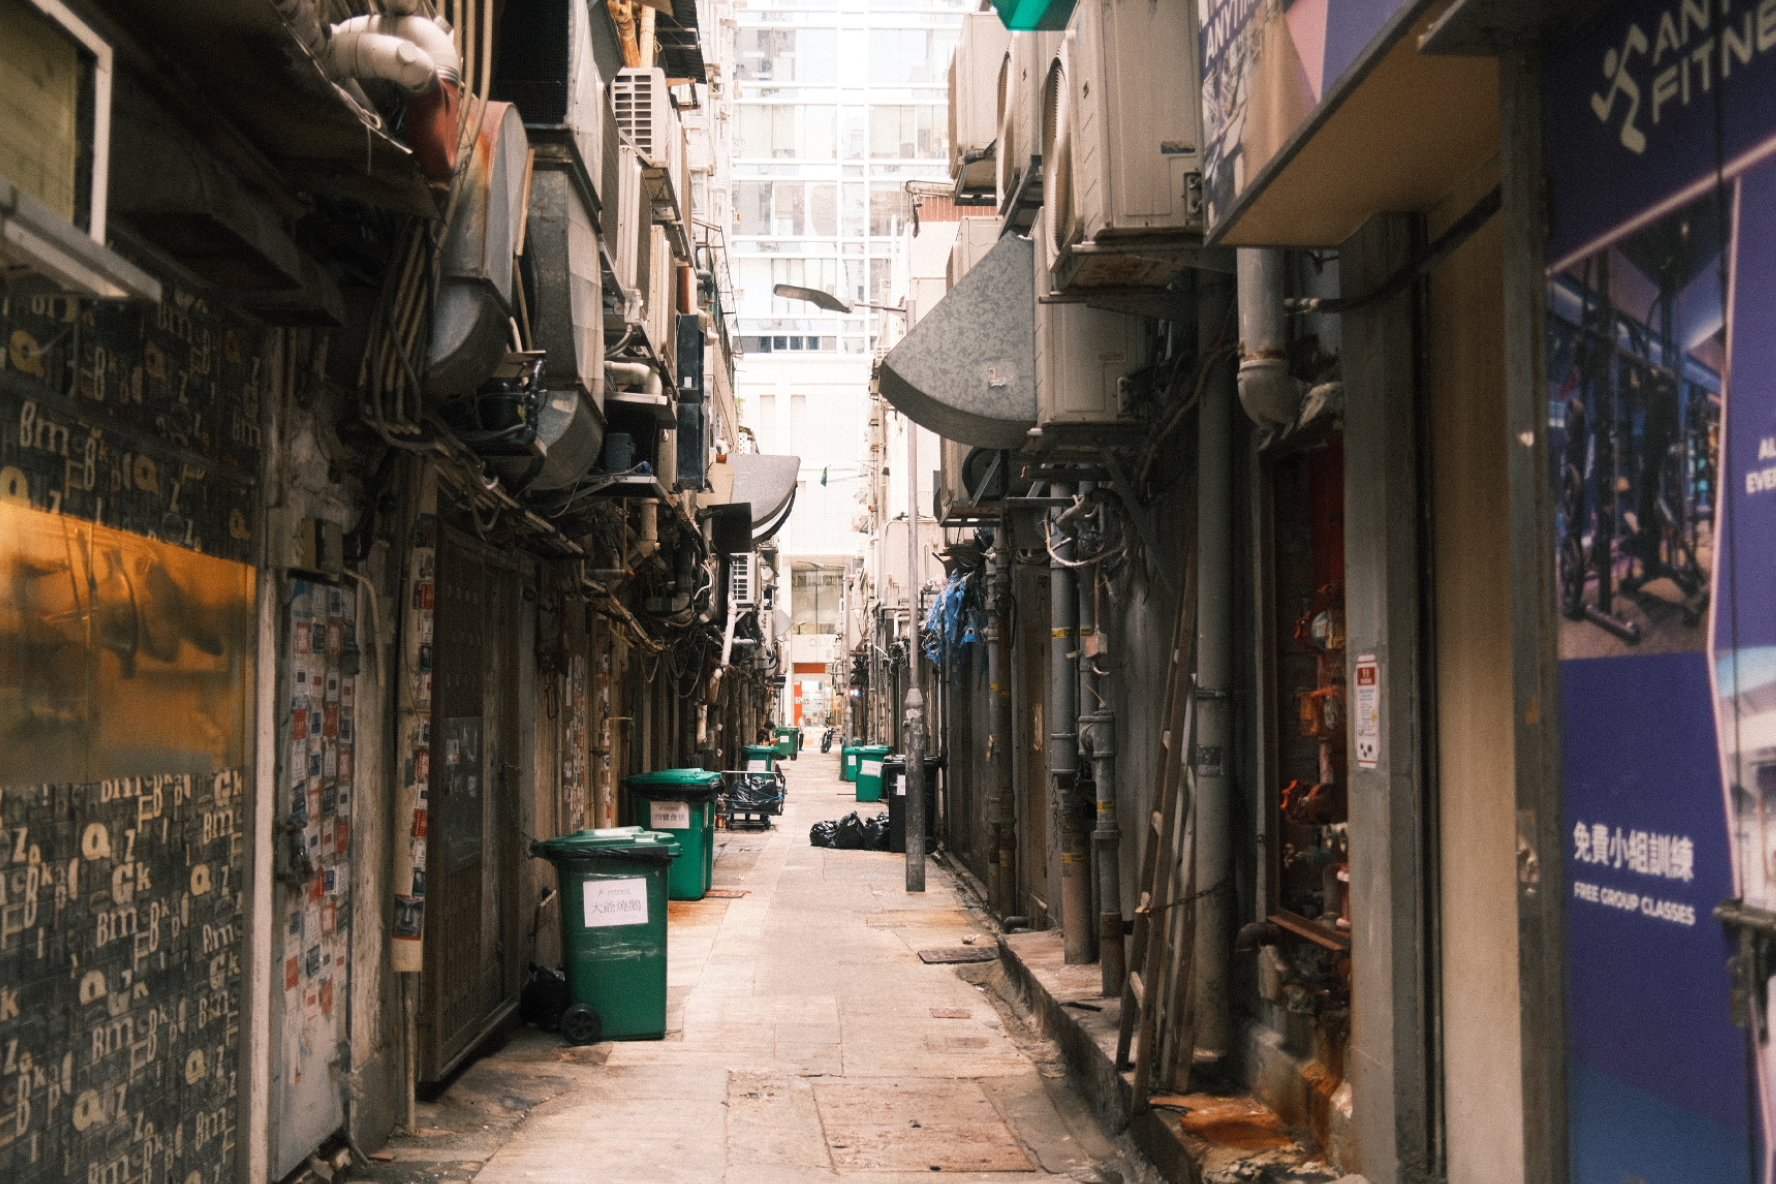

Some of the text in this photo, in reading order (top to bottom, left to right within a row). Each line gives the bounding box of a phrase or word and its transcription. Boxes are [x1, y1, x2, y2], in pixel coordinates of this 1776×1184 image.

[1574, 881, 1696, 926] FREE GROUP CLASSES
